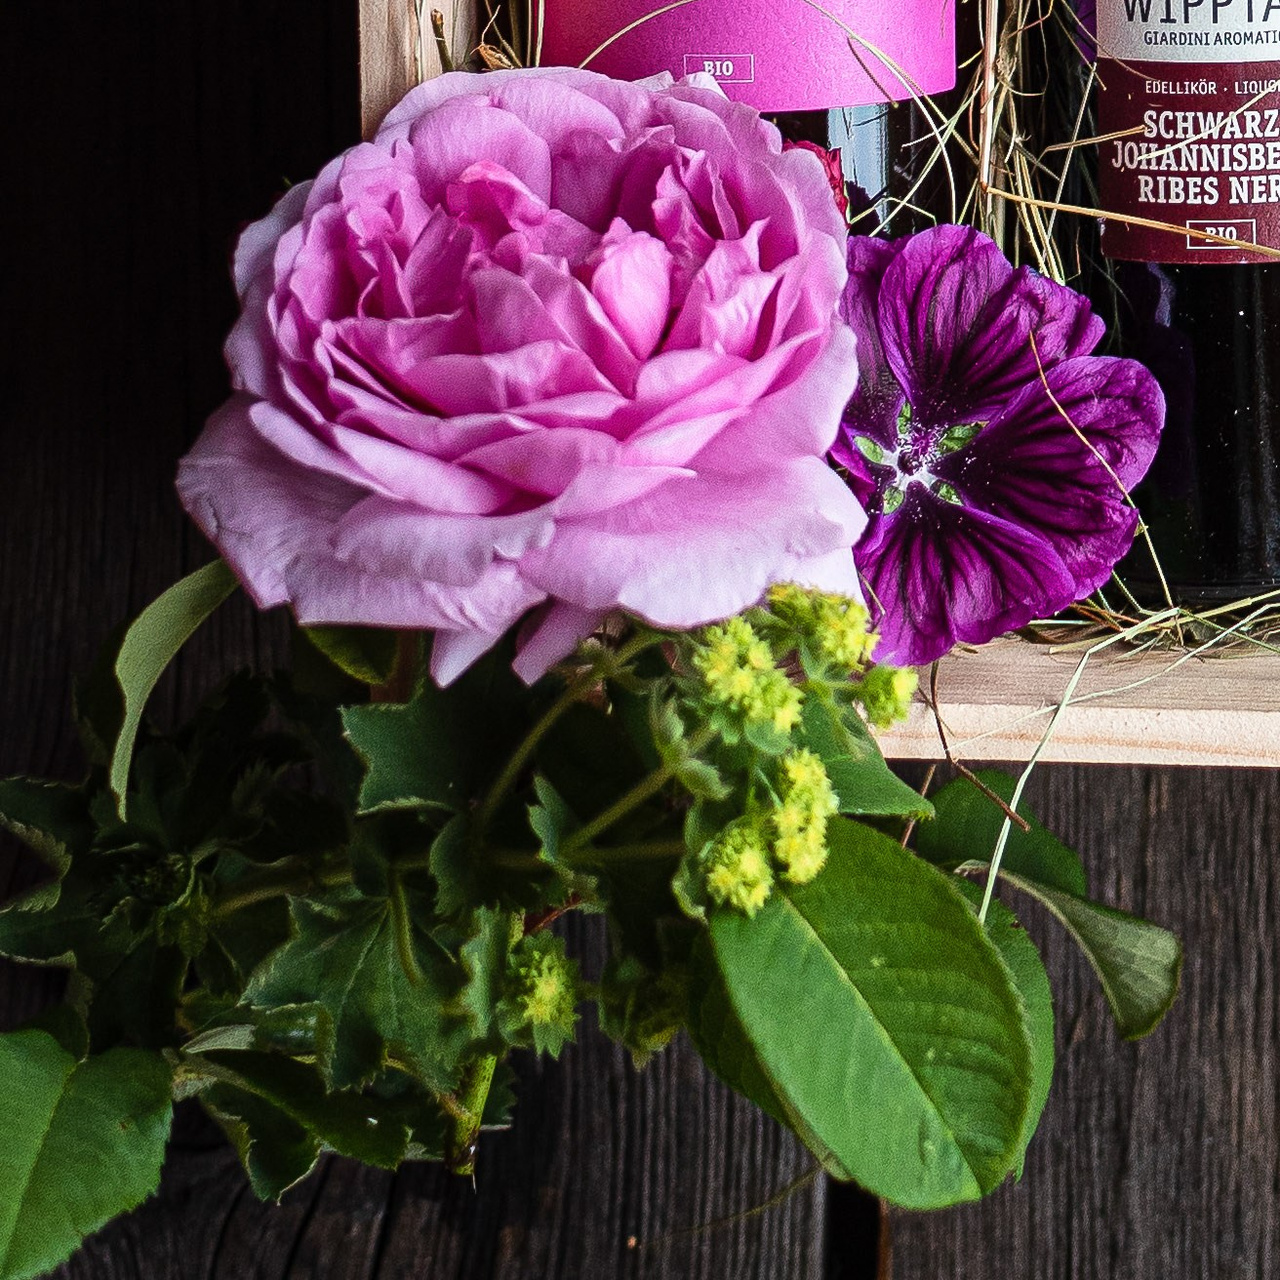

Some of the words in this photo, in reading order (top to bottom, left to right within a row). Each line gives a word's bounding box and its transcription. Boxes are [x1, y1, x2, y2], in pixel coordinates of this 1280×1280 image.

[1144, 30, 1210, 46] GIARDINI
[703, 61, 733, 76] BIO
[1146, 79, 1217, 95] EDELLIKÖR
[1138, 175, 1219, 204] RIBES
[1205, 226, 1237, 243] BIO
